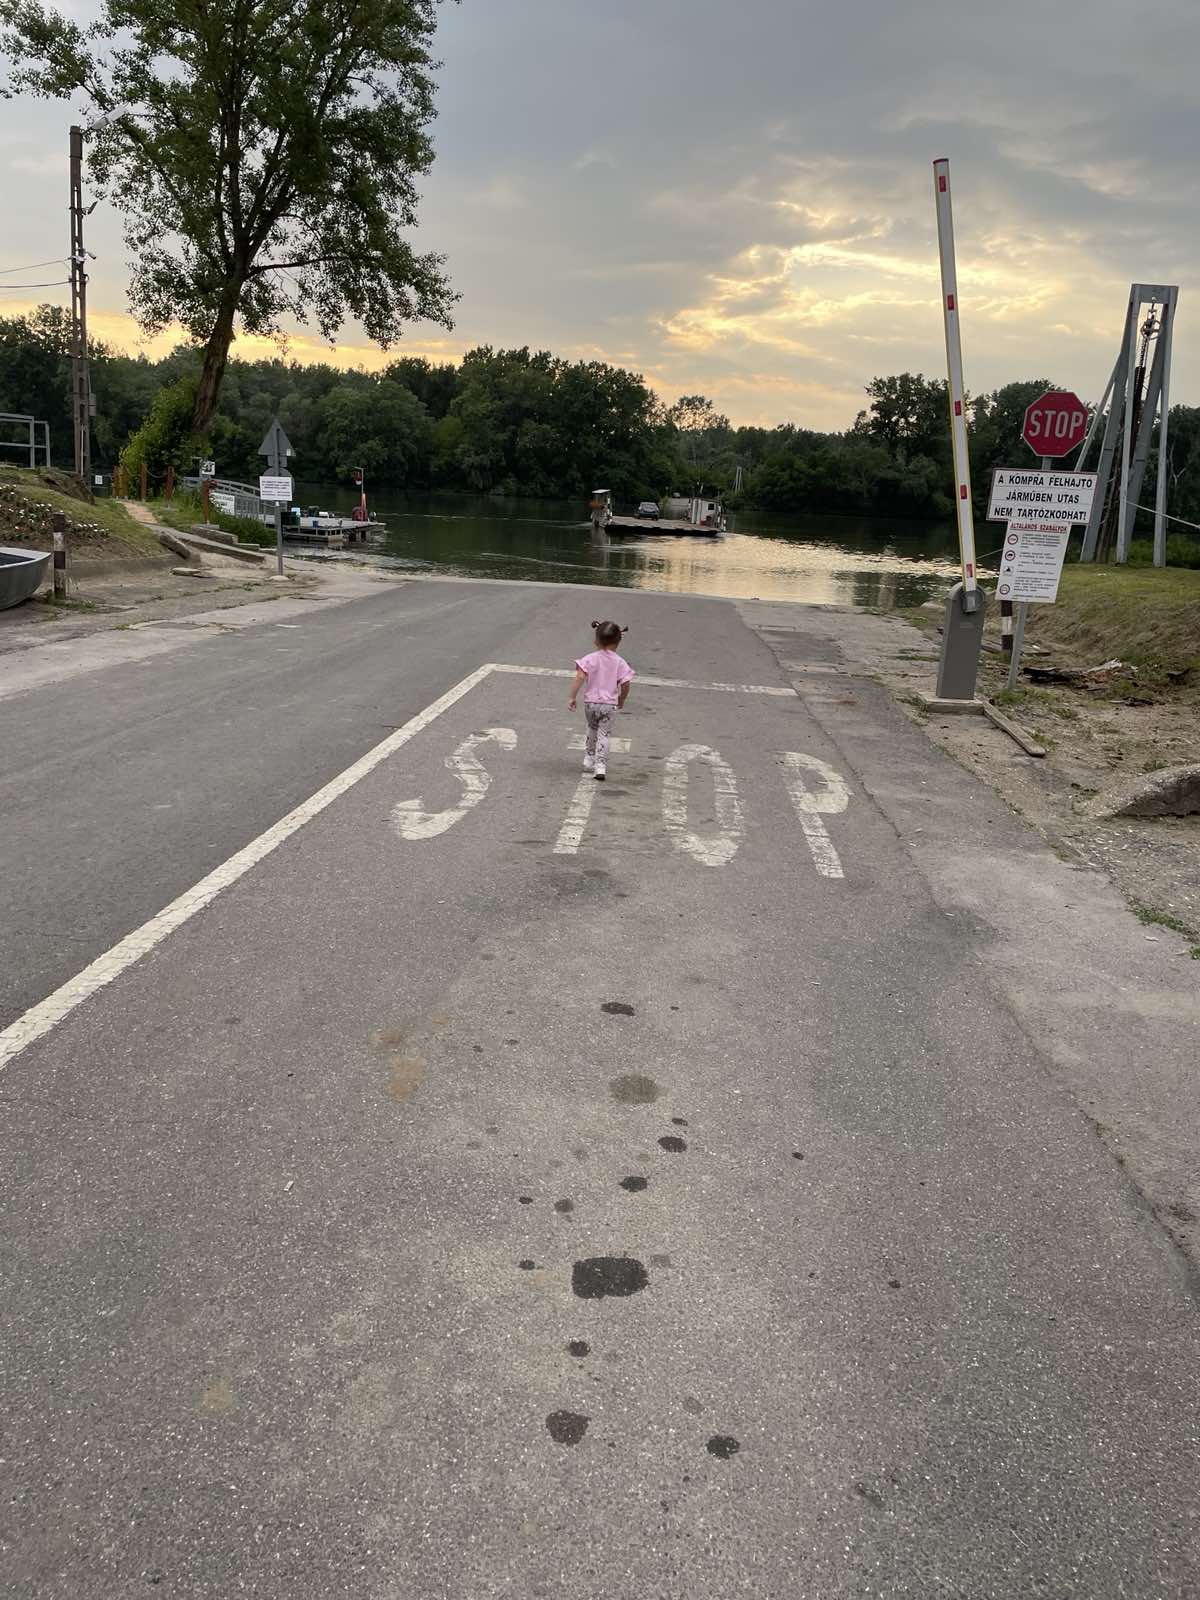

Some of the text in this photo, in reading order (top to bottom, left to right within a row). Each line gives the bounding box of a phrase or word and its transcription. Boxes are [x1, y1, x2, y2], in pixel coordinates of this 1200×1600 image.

[1028, 409, 1084, 439] STOP
[998, 474, 1004, 484] A
[1057, 494, 1080, 504] UTAS
[994, 507, 1013, 517] NEM
[391, 727, 854, 878] STOP
